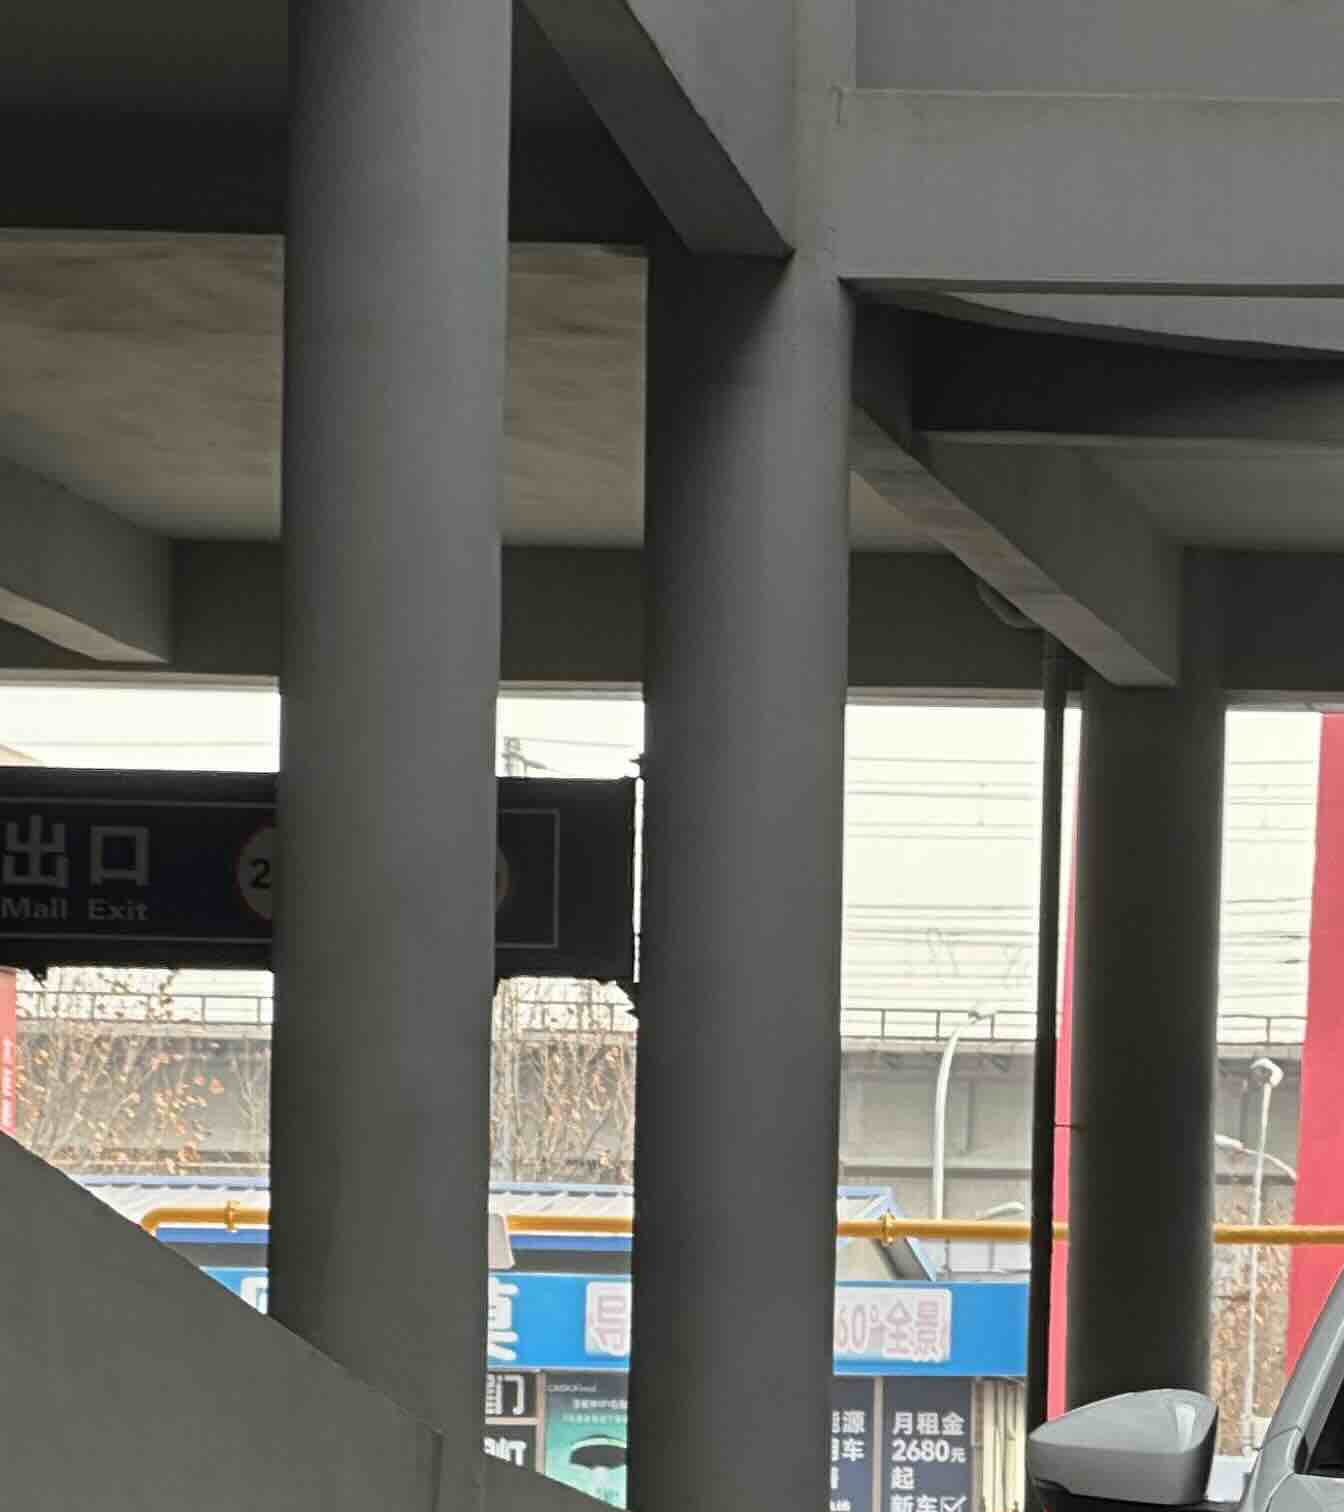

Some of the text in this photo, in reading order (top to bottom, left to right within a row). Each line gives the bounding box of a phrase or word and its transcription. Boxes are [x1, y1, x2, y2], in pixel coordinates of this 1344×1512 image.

[2, 814, 150, 889] 出口
[1, 896, 150, 921] Mall Exit
[892, 1411, 967, 1436] 月租金
[891, 1439, 967, 1463] 2680元
[890, 1466, 915, 1490] 起
